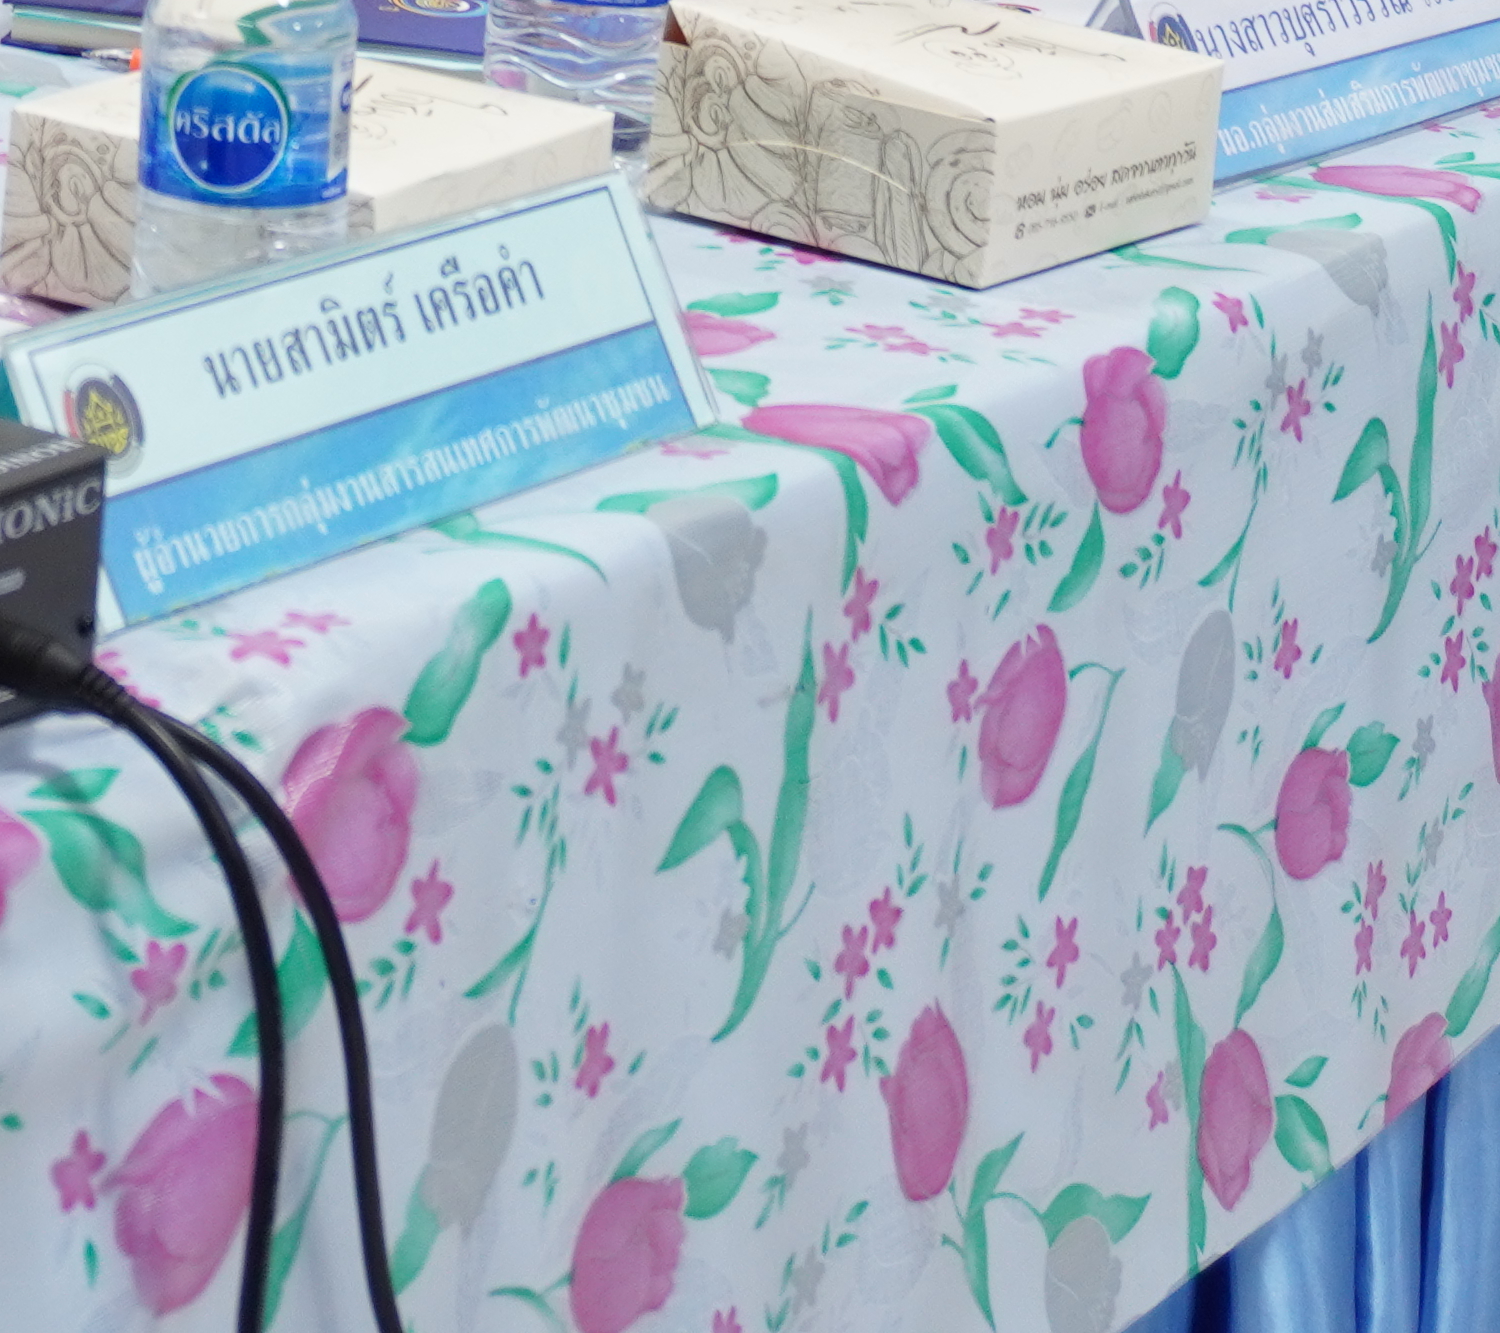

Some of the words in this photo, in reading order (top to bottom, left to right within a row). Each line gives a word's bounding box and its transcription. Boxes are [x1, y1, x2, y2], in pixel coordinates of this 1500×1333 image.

[203, 272, 407, 400] นายสามิตร์
[413, 244, 547, 335] เครือคำ
